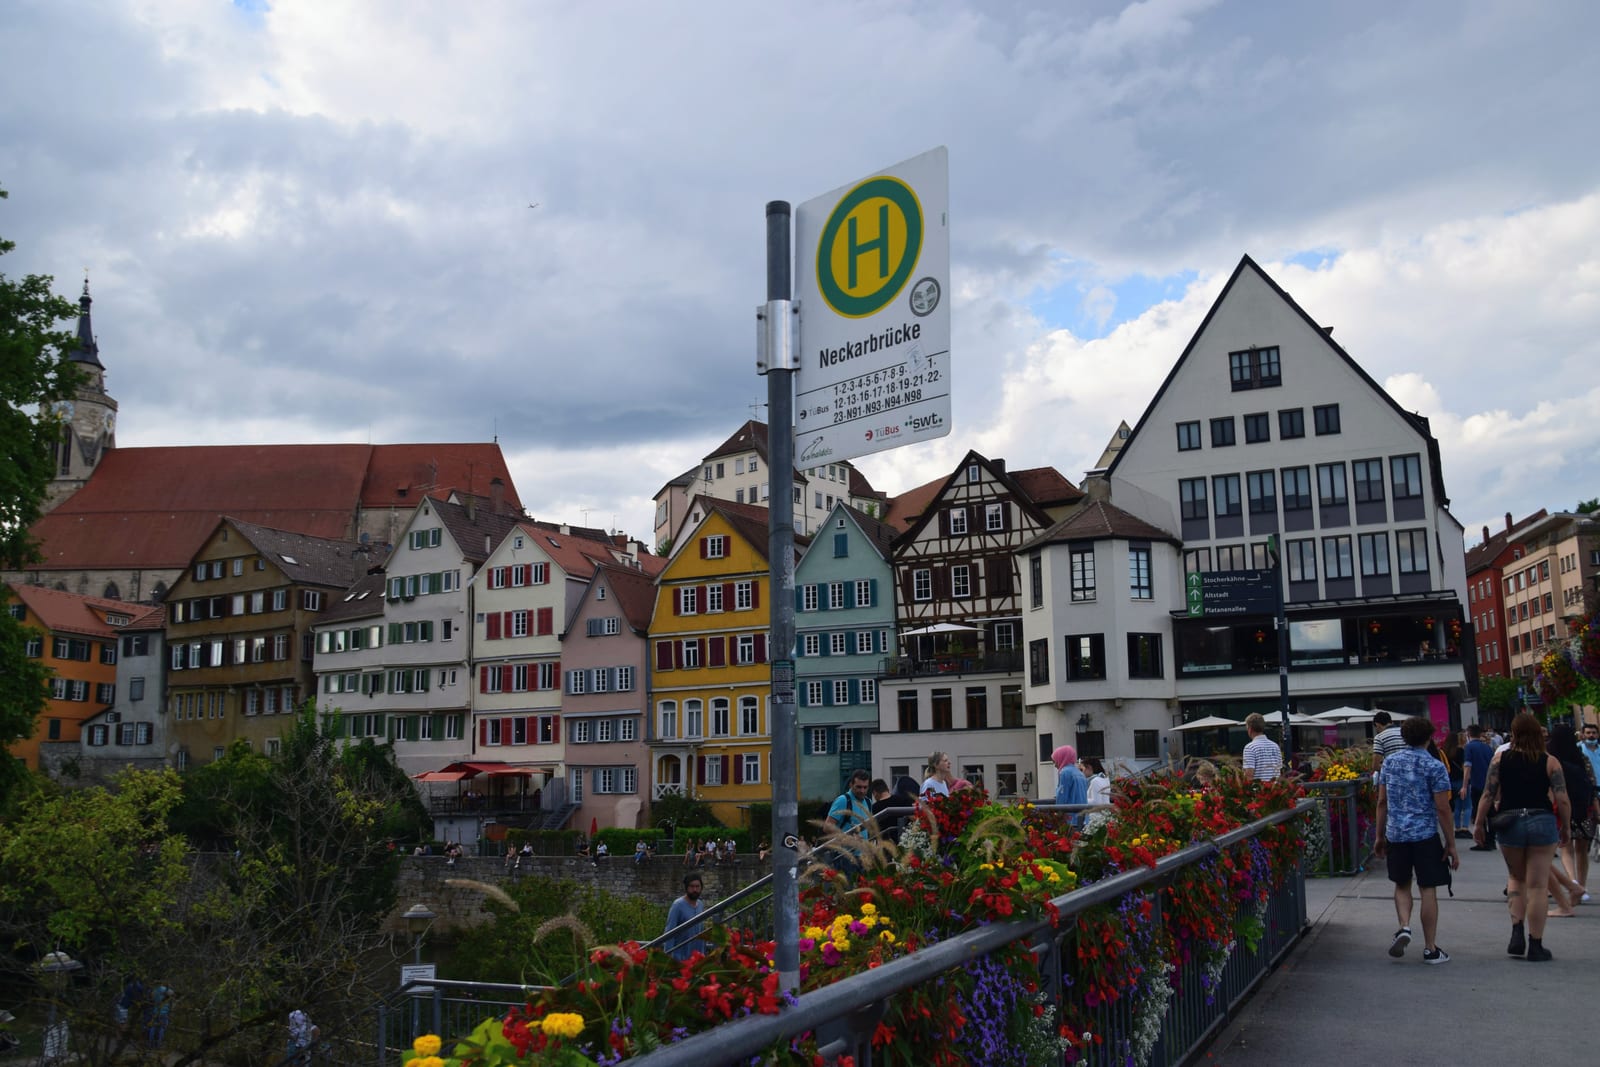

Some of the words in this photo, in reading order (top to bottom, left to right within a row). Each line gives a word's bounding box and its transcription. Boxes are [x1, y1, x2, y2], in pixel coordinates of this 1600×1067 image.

[848, 204, 889, 290] H
[819, 322, 921, 368] Neckarbrücke
[874, 425, 900, 438] TüBus
[1203, 576, 1246, 584] Stocherkähne
[1204, 606, 1247, 614] Platanenallee
